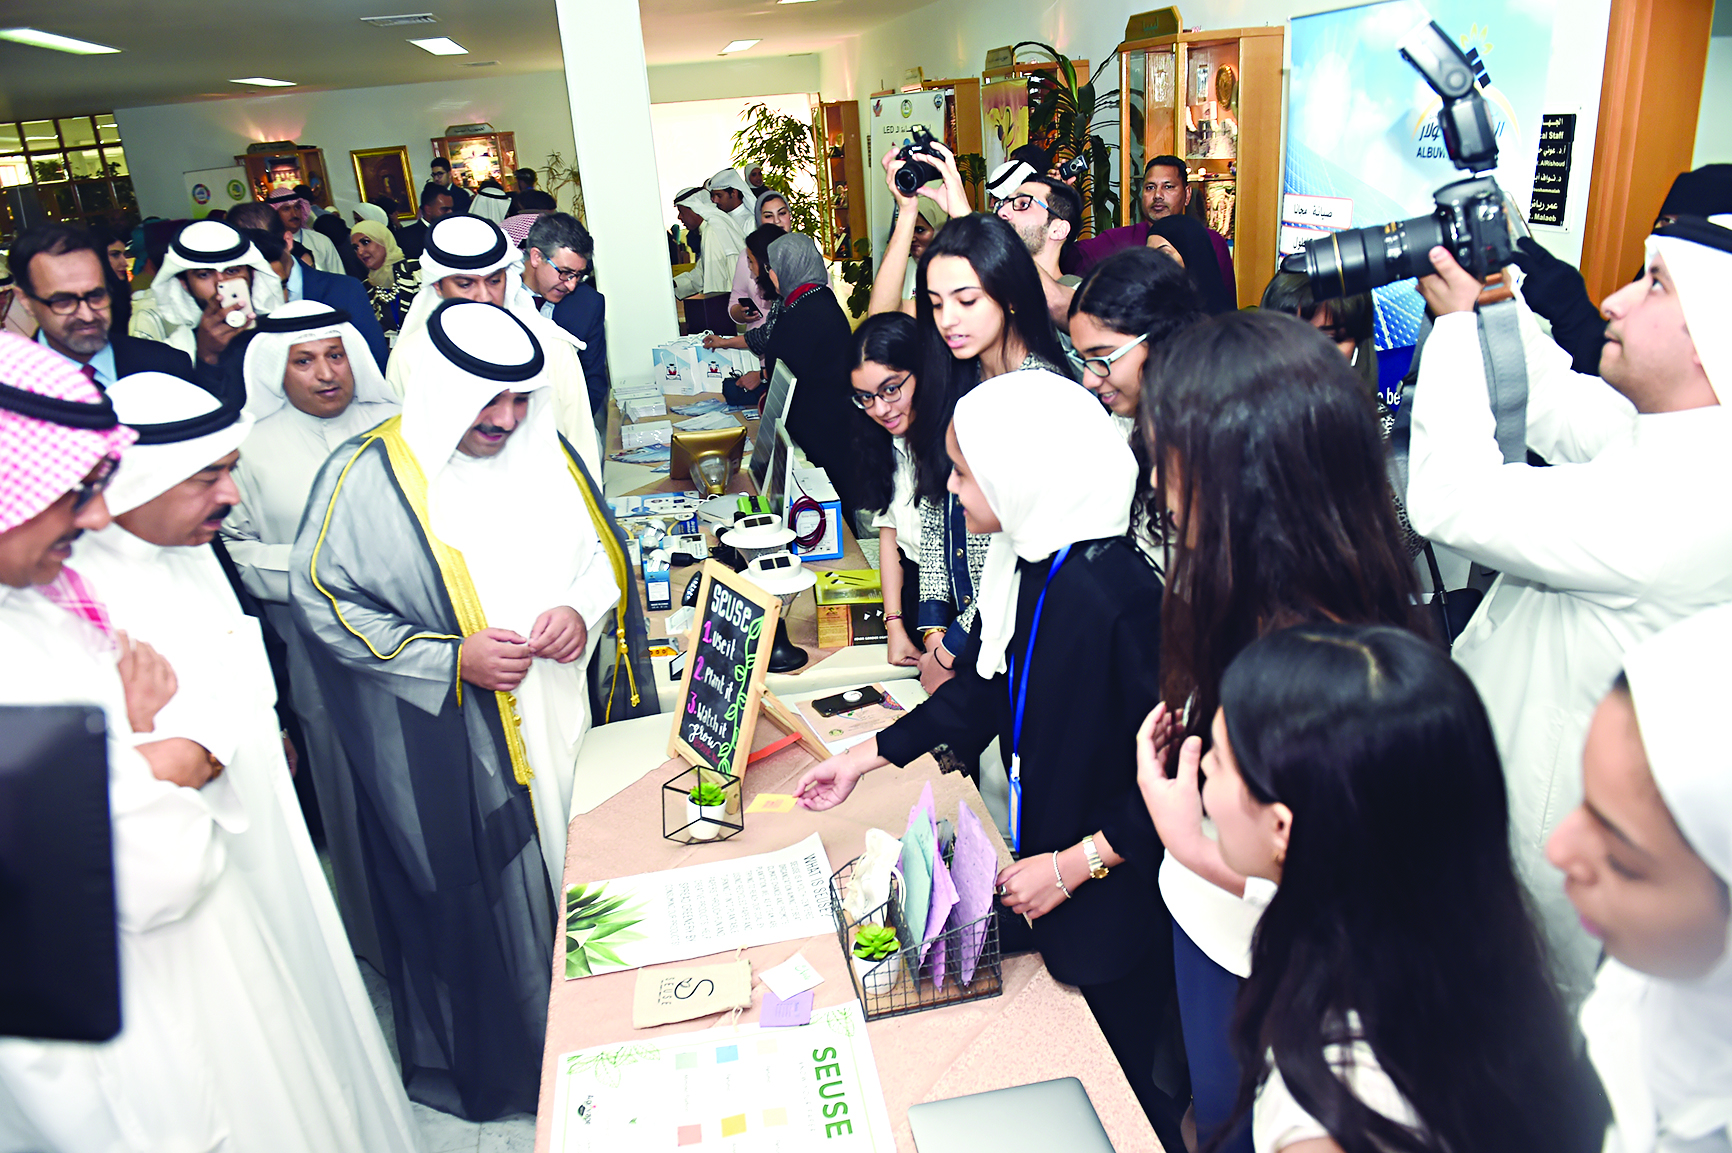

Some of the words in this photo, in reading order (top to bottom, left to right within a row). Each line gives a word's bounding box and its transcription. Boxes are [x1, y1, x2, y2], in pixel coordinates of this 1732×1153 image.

[1548, 131, 1565, 140] Staff
[1533, 213, 1557, 222] Malaeb
[1386, 387, 1401, 405] be
[802, 852, 821, 877] WHAT
[809, 877, 824, 887] IS
[812, 886, 833, 918] SEUSE?
[661, 976, 676, 1005] SEUSE
[812, 1046, 853, 1139] SEUSE
